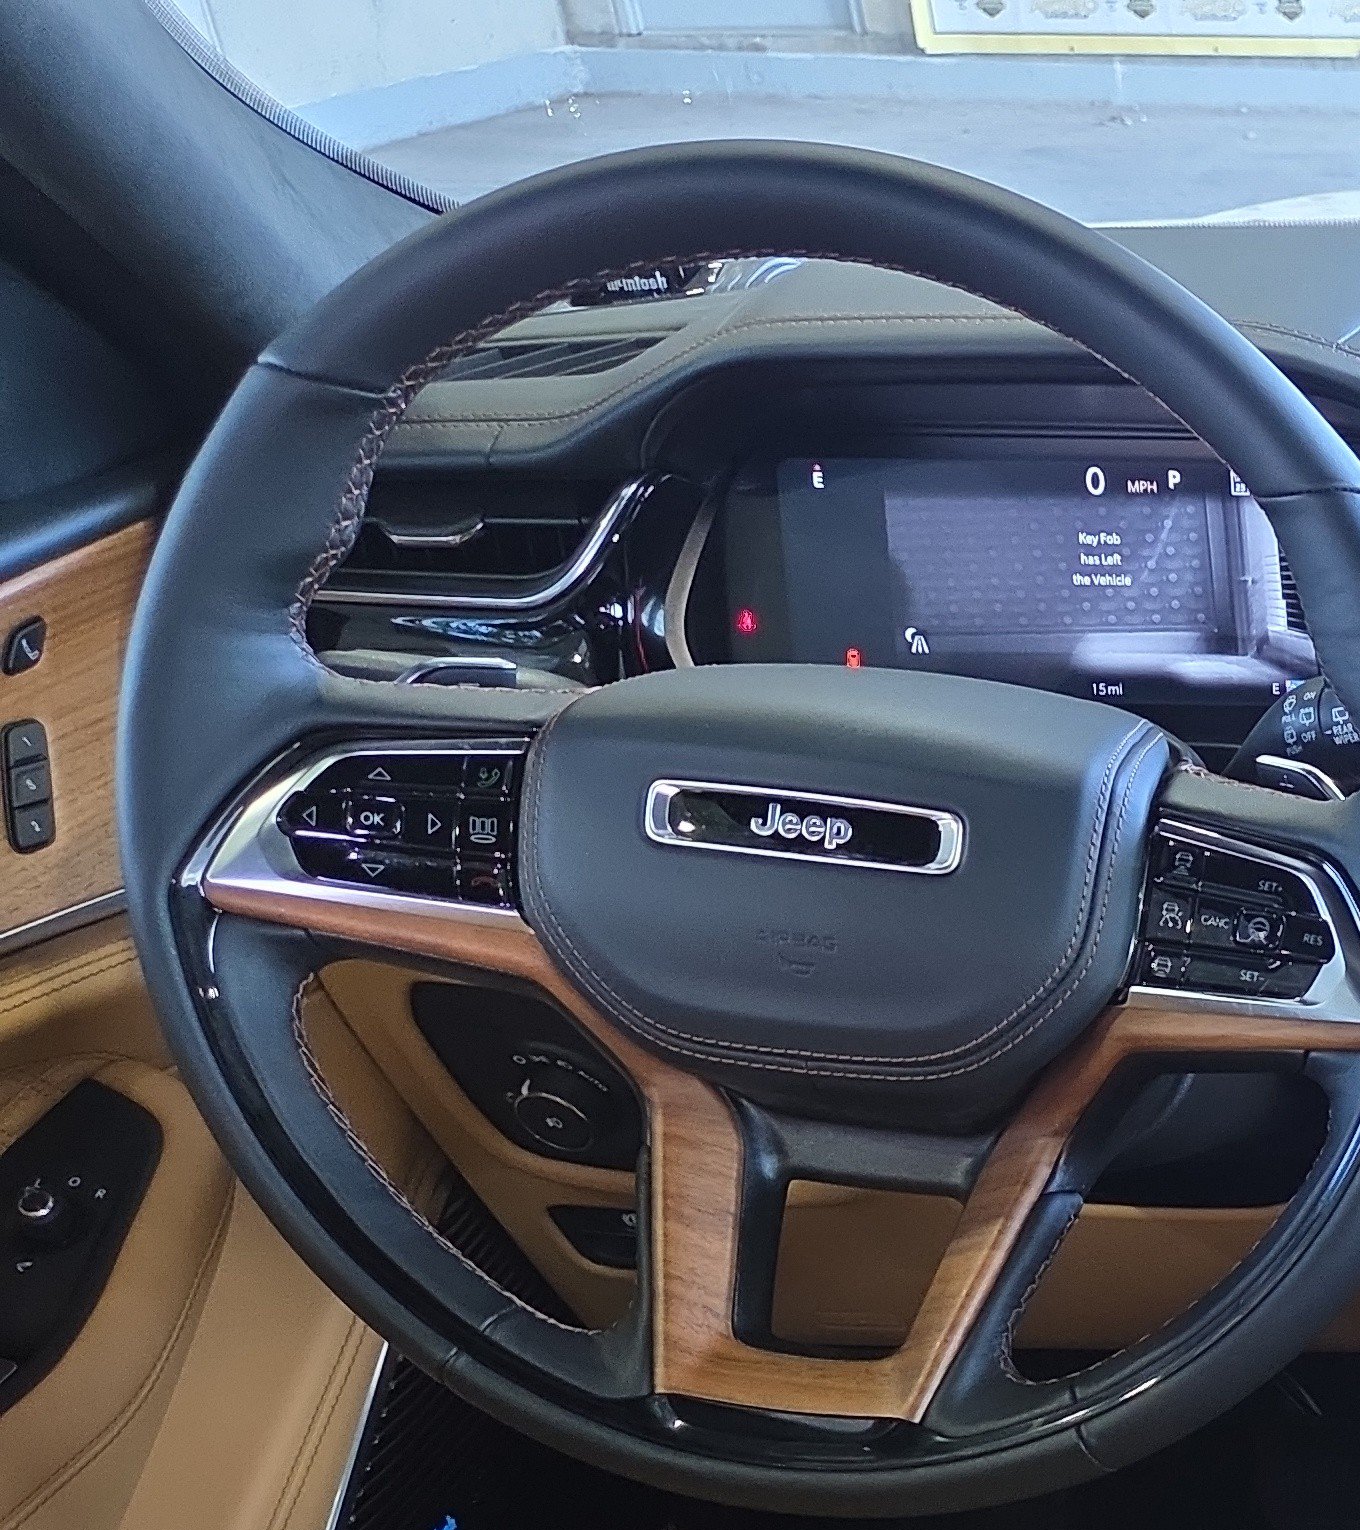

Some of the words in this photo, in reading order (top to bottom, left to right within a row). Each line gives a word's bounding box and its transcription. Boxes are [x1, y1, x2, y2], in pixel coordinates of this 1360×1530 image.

[1085, 466, 1106, 496] 0
[1127, 480, 1158, 494] MPH
[1168, 469, 1181, 490] P
[1078, 531, 1098, 548] Key
[1100, 532, 1121, 545] Fob
[1080, 553, 1100, 566] has
[1101, 553, 1122, 566] Left
[1072, 573, 1090, 586] the
[1091, 574, 1132, 587] Vehicle
[1272, 682, 1281, 695] E
[1301, 731, 1317, 743] OFF
[360, 811, 385, 826] OK
[750, 802, 853, 850] Jeep
[1257, 880, 1283, 893] SET+
[1200, 915, 1230, 930] CANC
[1302, 933, 1324, 947] RES
